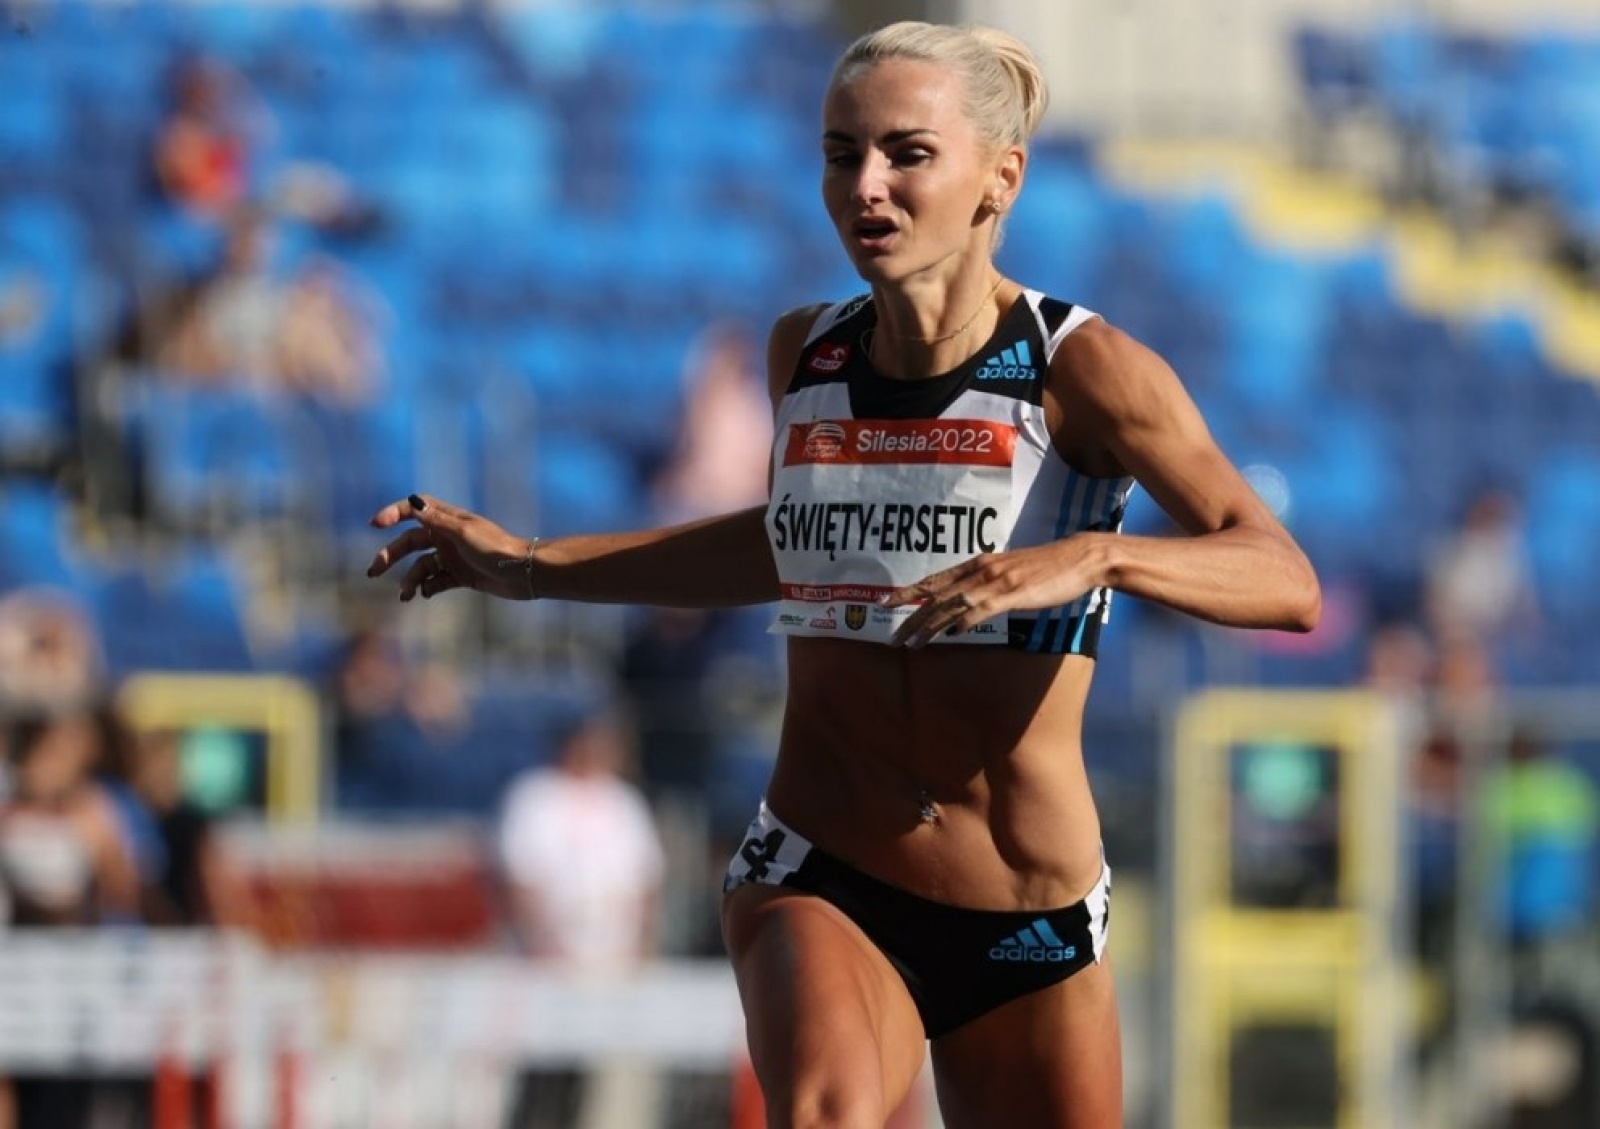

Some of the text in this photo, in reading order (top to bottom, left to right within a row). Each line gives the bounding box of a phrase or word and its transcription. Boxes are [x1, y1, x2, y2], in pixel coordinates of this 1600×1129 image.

[976, 365, 1036, 380] adidas
[856, 428, 994, 453] Silesia2022
[773, 493, 998, 561] ŚWIĘTY-ERSETIC
[989, 945, 1076, 962] adidas
